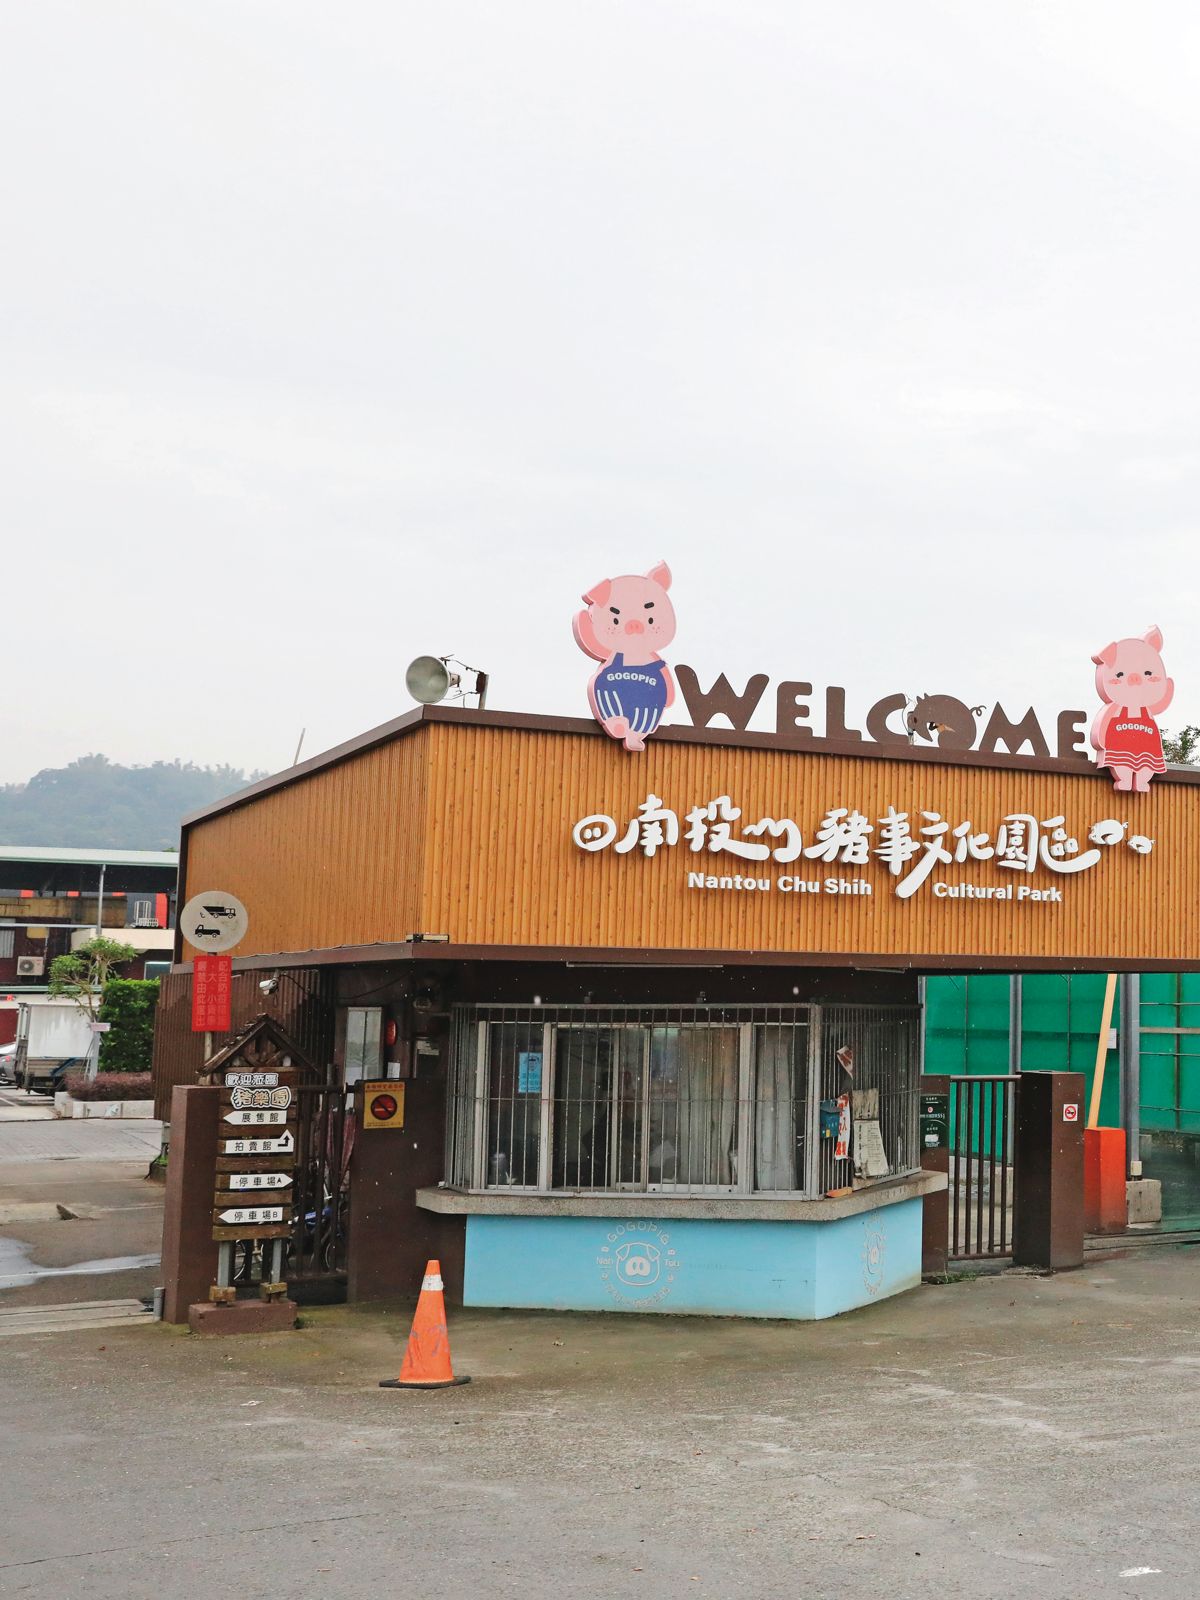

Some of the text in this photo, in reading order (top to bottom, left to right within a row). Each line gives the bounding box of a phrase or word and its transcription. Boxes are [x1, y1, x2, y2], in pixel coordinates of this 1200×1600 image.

[606, 672, 657, 687] GOGOPIG
[674, 664, 1089, 761] WELCOME
[1115, 723, 1154, 735] GOGOPIG
[687, 871, 1064, 903] Nantou Chu Shih Cultural Park
[241, 1112, 279, 1123] 展售館
[235, 1140, 272, 1152] 拍賣館
[234, 1209, 278, 1221] 停車場B
[607, 1220, 670, 1246] GOGOPIG
